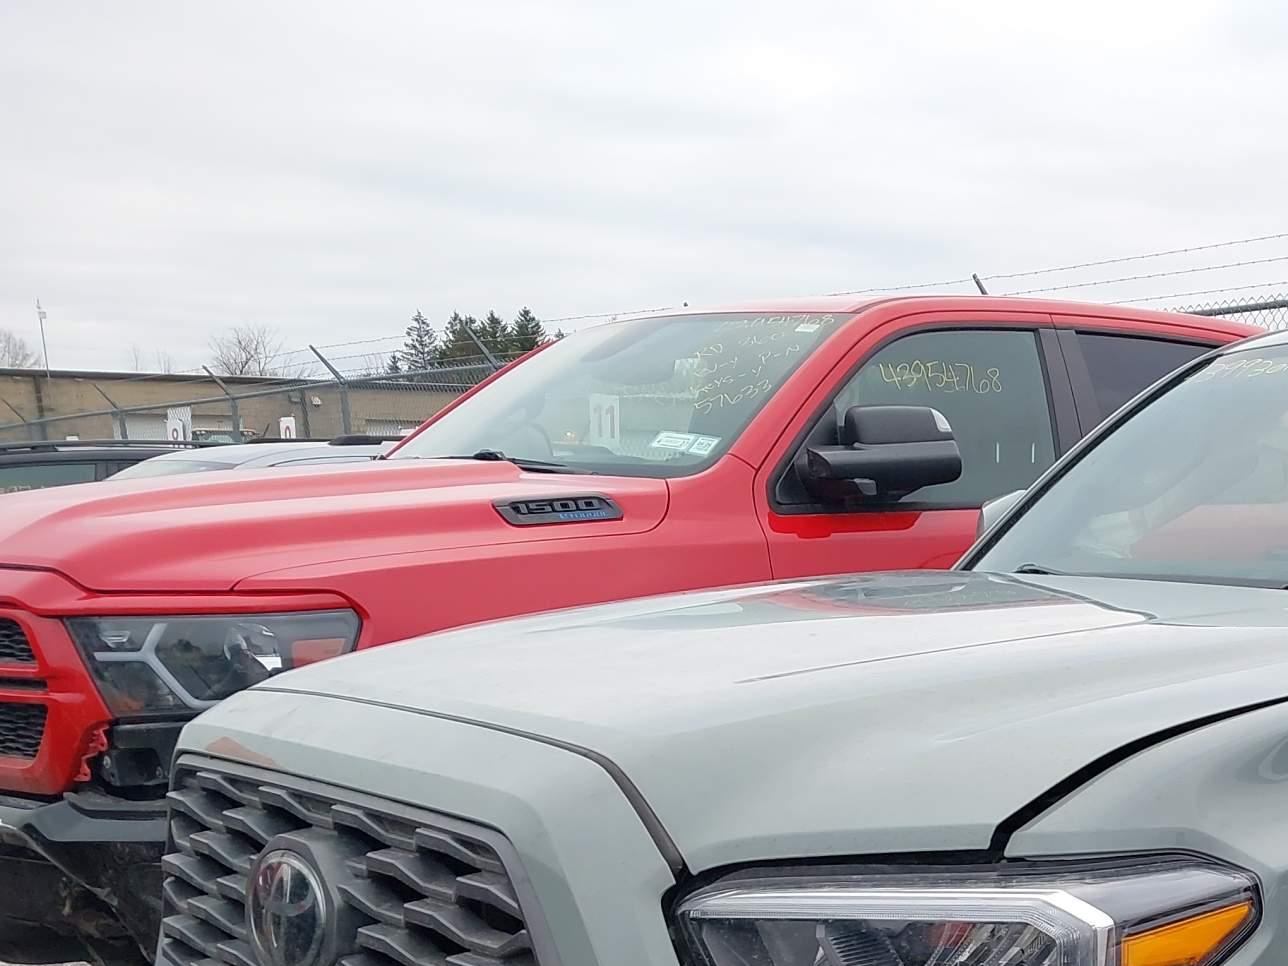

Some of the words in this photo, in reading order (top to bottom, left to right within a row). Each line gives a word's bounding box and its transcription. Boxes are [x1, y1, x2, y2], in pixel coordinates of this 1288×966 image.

[879, 359, 1002, 394] 43954768
[694, 379, 772, 415] 57633
[512, 499, 601, 515] 1500
